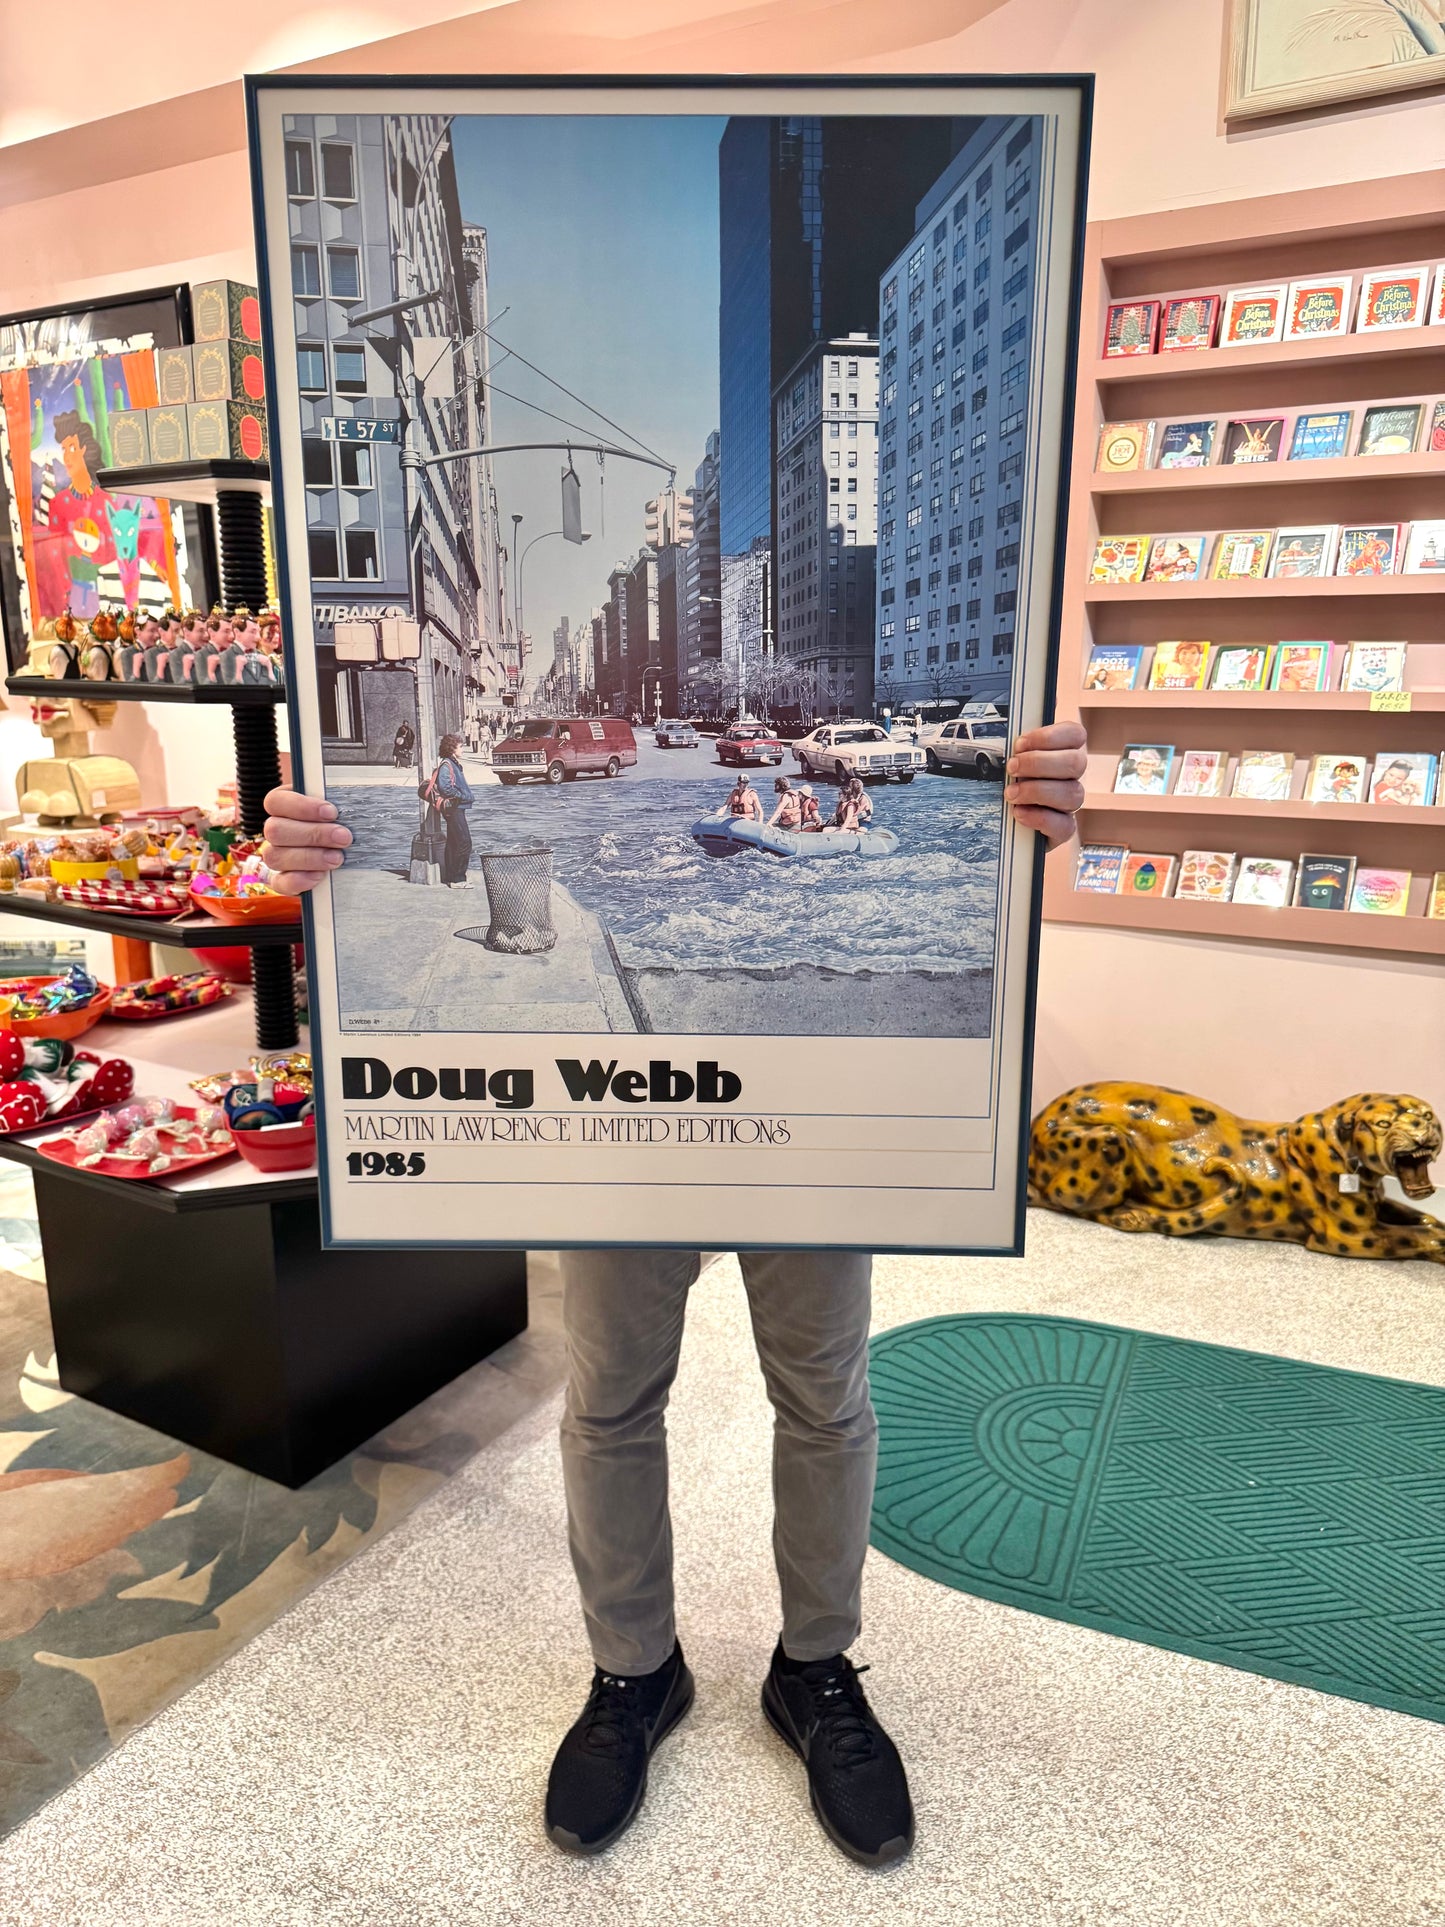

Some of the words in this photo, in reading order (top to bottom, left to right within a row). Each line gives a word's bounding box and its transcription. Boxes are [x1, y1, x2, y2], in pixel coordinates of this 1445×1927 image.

[1383, 289, 1409, 301] Before
[1308, 297, 1333, 310] Before
[1373, 301, 1416, 315] Christmas
[1246, 307, 1269, 320] Before
[1298, 308, 1340, 321] Christmas
[1235, 319, 1276, 332] Christmas
[1366, 411, 1415, 424] Welcome
[338, 421, 349, 437] E
[356, 421, 377, 439] 57
[382, 423, 394, 432] ST
[1095, 657, 1129, 665] BOOZE
[1164, 678, 1186, 687] SHE
[1375, 692, 1409, 701] CARDS
[341, 1057, 534, 1109] Doug
[555, 1059, 742, 1103] Webb
[344, 1116, 435, 1141] MARTIN
[443, 1116, 571, 1141] LAWRENCE
[581, 1117, 670, 1142] LIMITED
[676, 1118, 791, 1144] EDITIONS
[346, 1151, 426, 1176] 1985
